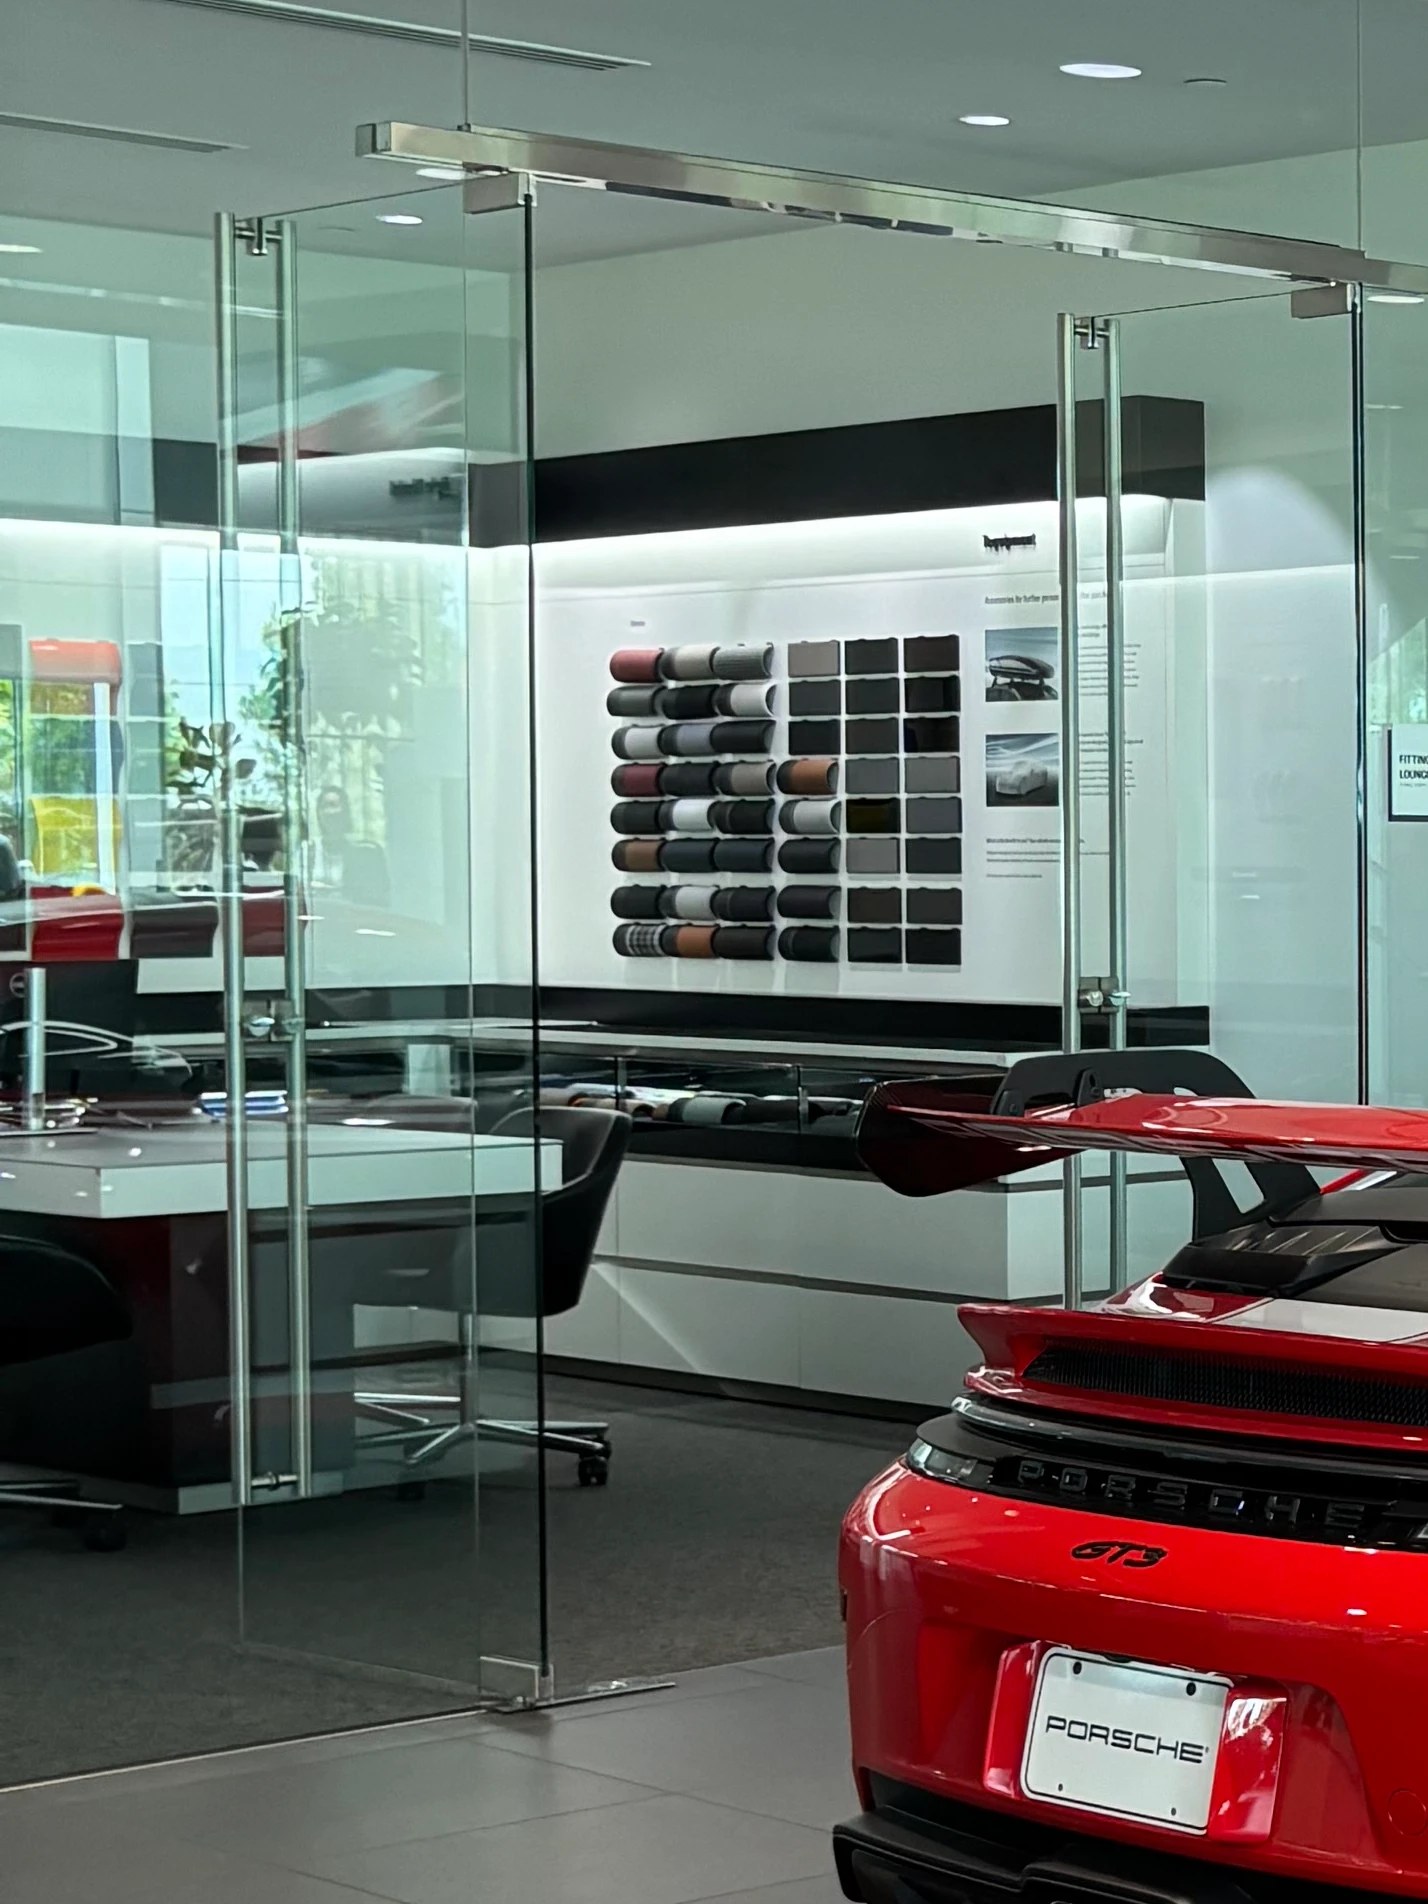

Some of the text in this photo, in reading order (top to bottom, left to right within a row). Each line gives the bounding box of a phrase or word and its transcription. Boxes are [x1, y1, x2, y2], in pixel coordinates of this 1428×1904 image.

[1017, 1459, 1366, 1528] PORSCHE
[1071, 1541, 1169, 1568] GT3
[1046, 1715, 1205, 1764] PORSCHE
